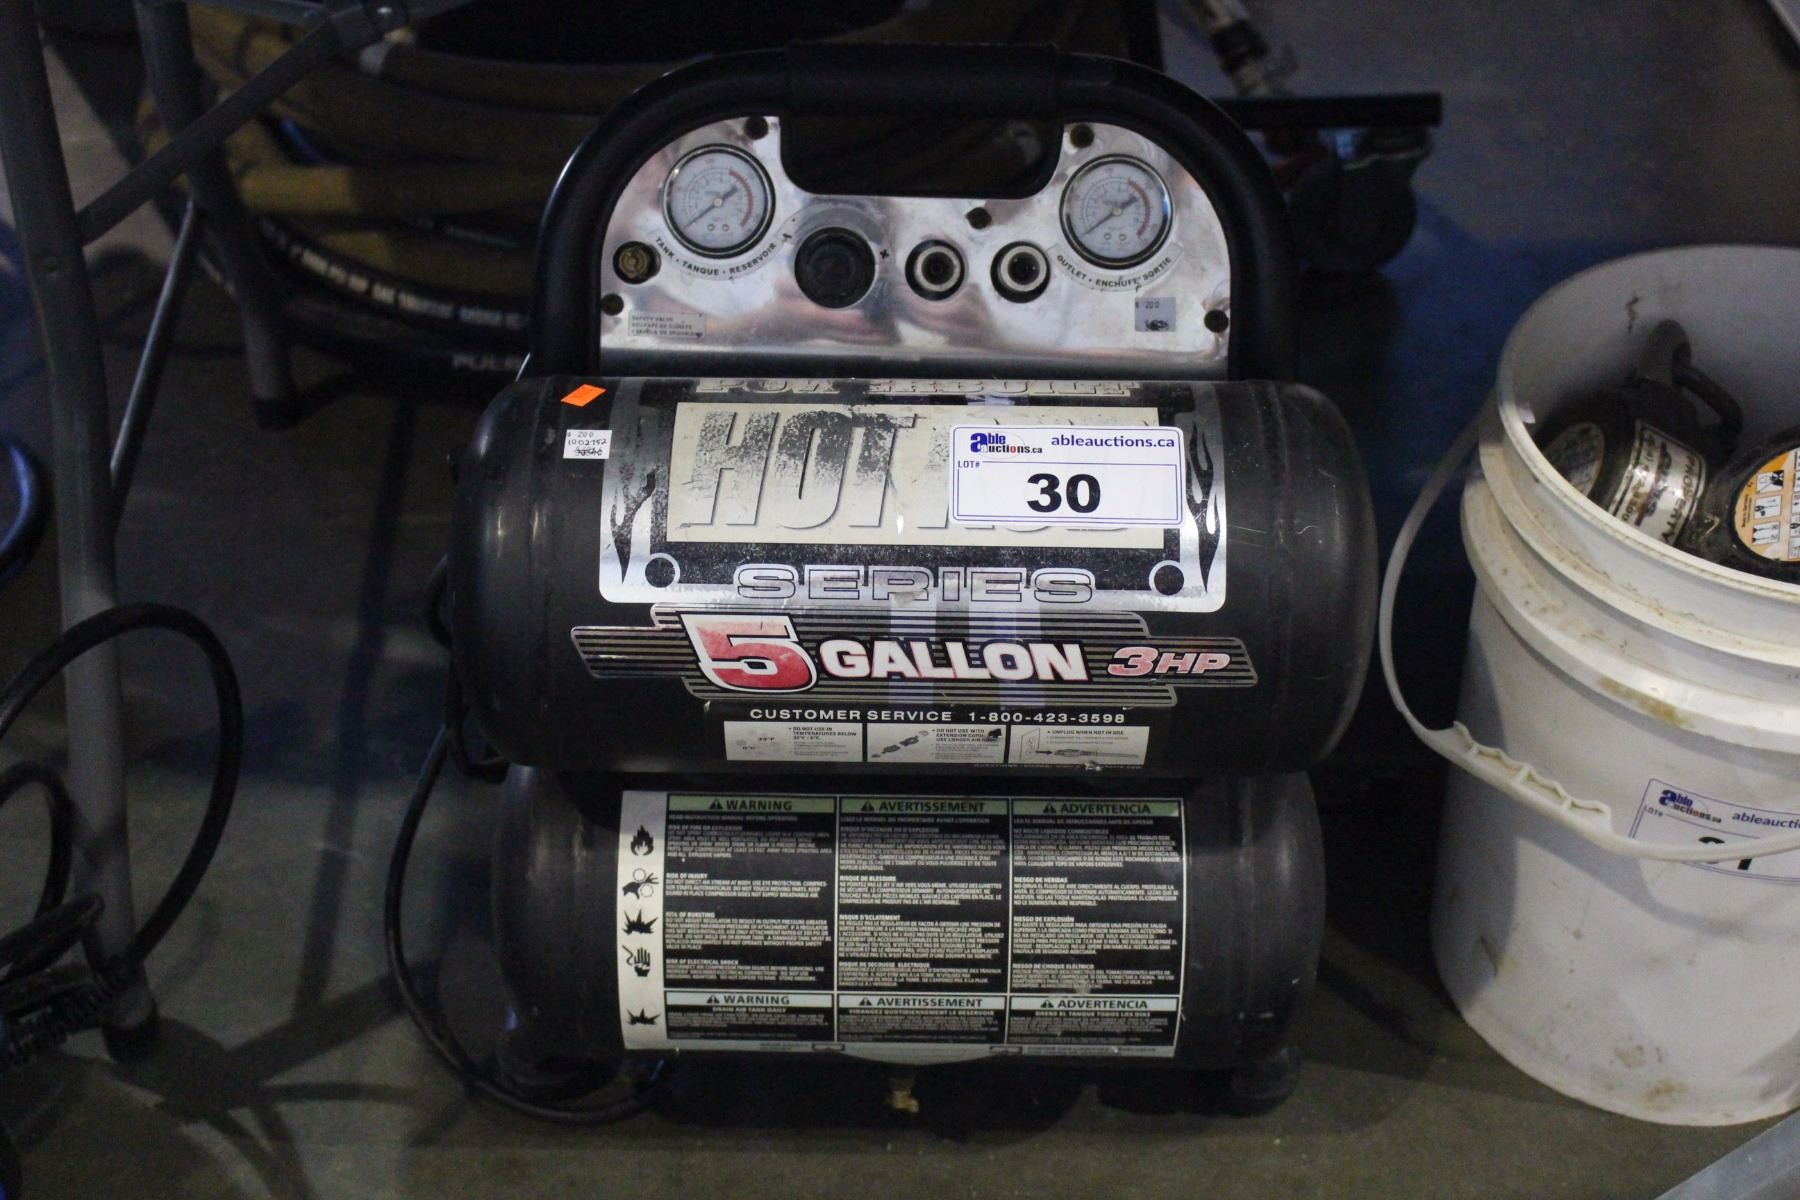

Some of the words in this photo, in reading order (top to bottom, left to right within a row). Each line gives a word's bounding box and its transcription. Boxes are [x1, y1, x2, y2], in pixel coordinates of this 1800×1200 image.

[655, 237, 675, 259] TANK
[682, 260, 719, 275] TANQUE
[1056, 254, 1087, 281] OUTLET
[1095, 278, 1138, 288] ENCHUFE
[1143, 256, 1171, 281] SORTIE
[1051, 434, 1175, 448] ableauctions.ca
[681, 410, 927, 530] HOT
[958, 460, 980, 468] LOT#
[1026, 473, 1101, 514] 30
[736, 566, 1093, 603] SERIES
[680, 612, 818, 694] 5
[819, 638, 1089, 682] GALLON
[1107, 646, 1231, 677] 3HP
[750, 709, 861, 720] CUSTOMER
[867, 710, 952, 721] SERVICE
[969, 712, 1125, 723] 1-800-423-3598
[727, 799, 792, 811] WARNING
[879, 801, 985, 813] AVERTISSEMENT
[1060, 803, 1152, 814] ADVERTENCIA
[1732, 812, 1800, 829] ableaucti
[724, 995, 790, 1005] WARNING
[877, 998, 982, 1007] AVERTISSEMENT
[1058, 999, 1148, 1009] ADVERTENCIA
